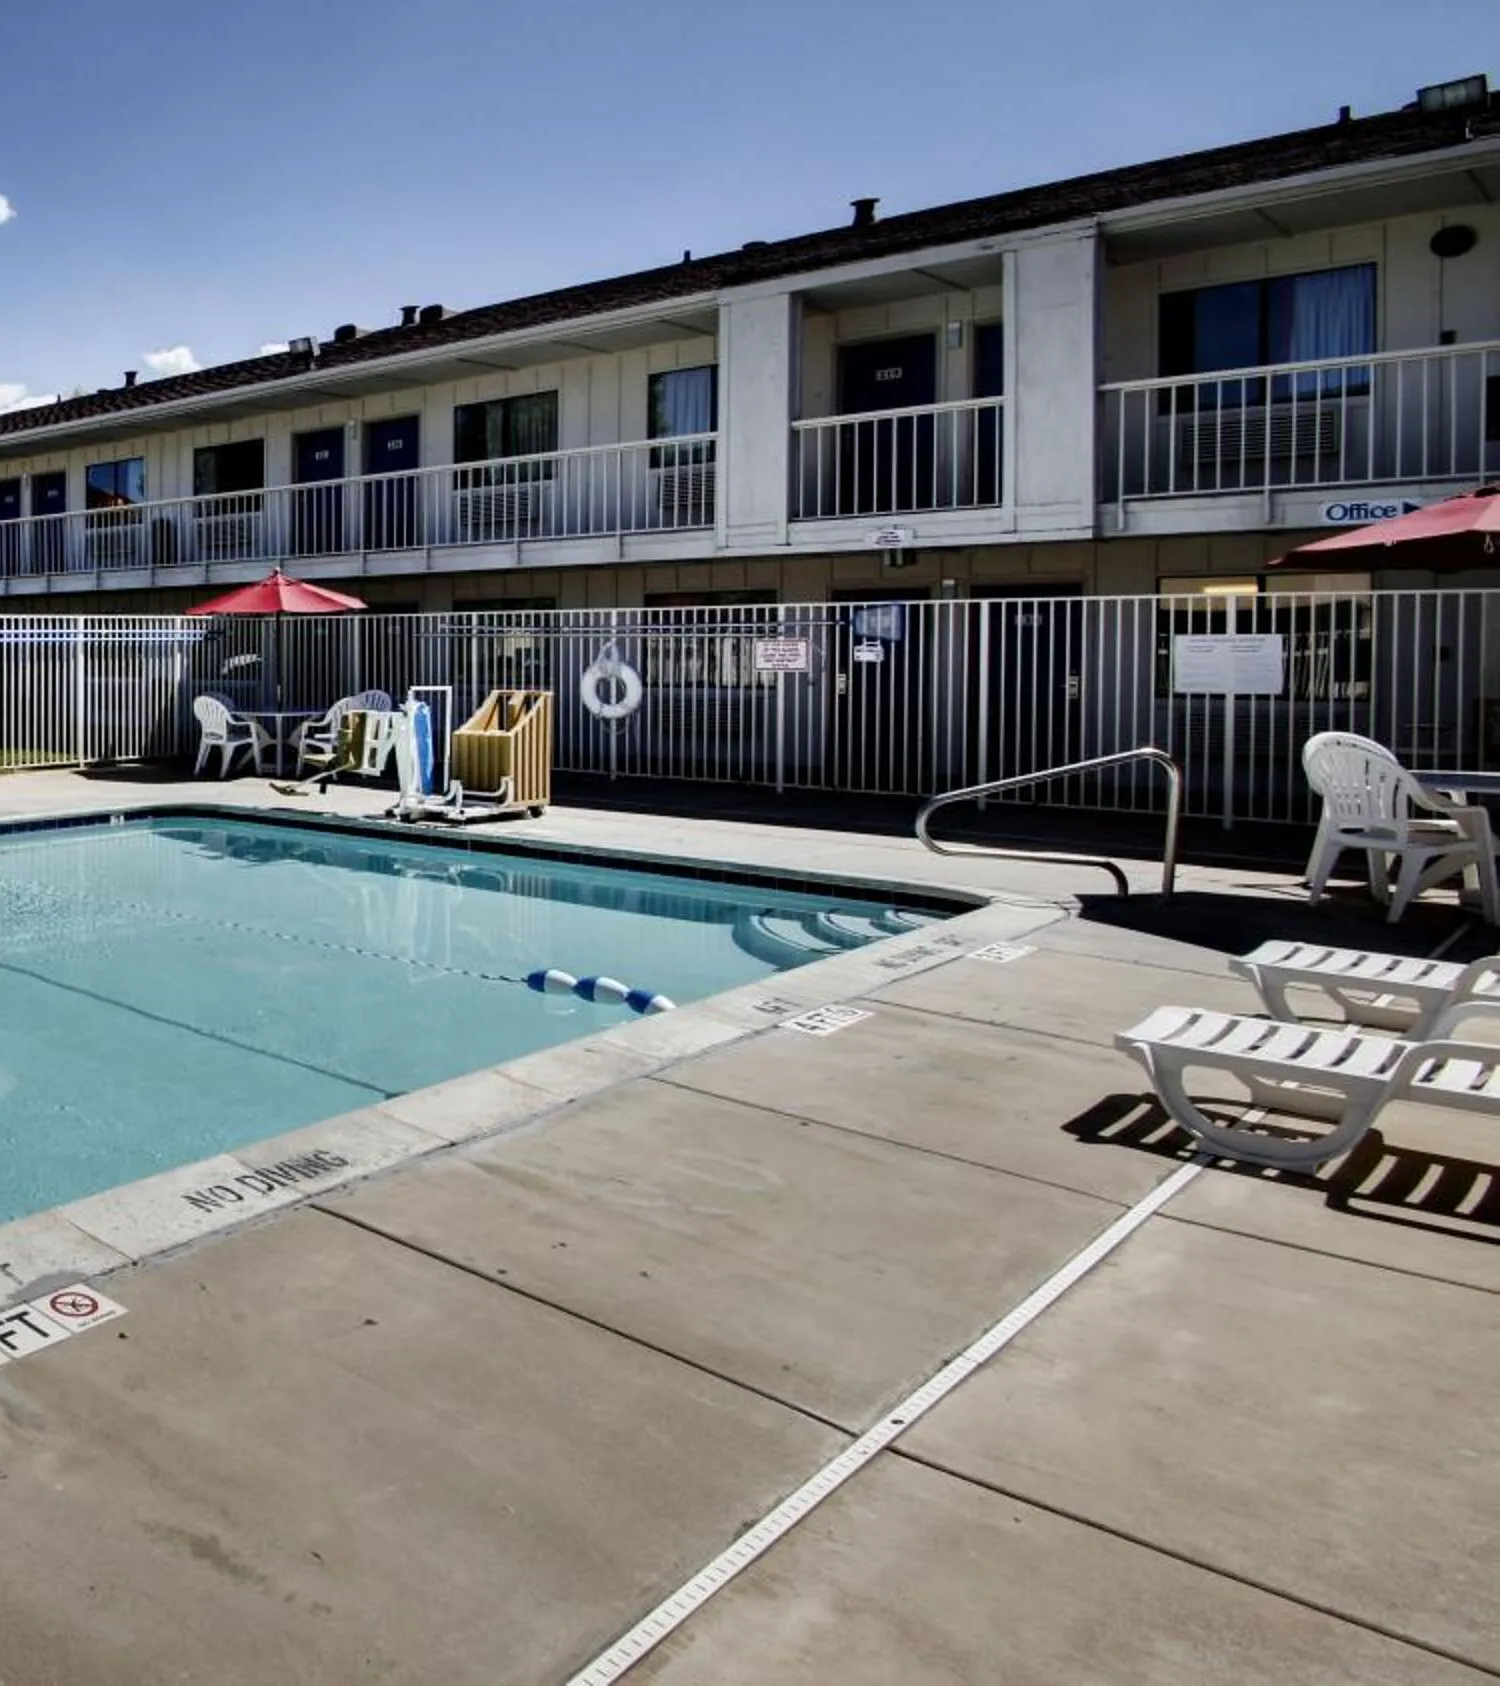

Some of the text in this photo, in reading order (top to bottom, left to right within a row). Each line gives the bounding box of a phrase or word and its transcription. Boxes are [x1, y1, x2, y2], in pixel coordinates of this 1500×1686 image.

[1326, 503, 1397, 521] Office
[180, 1150, 349, 1213] NO DIVING
